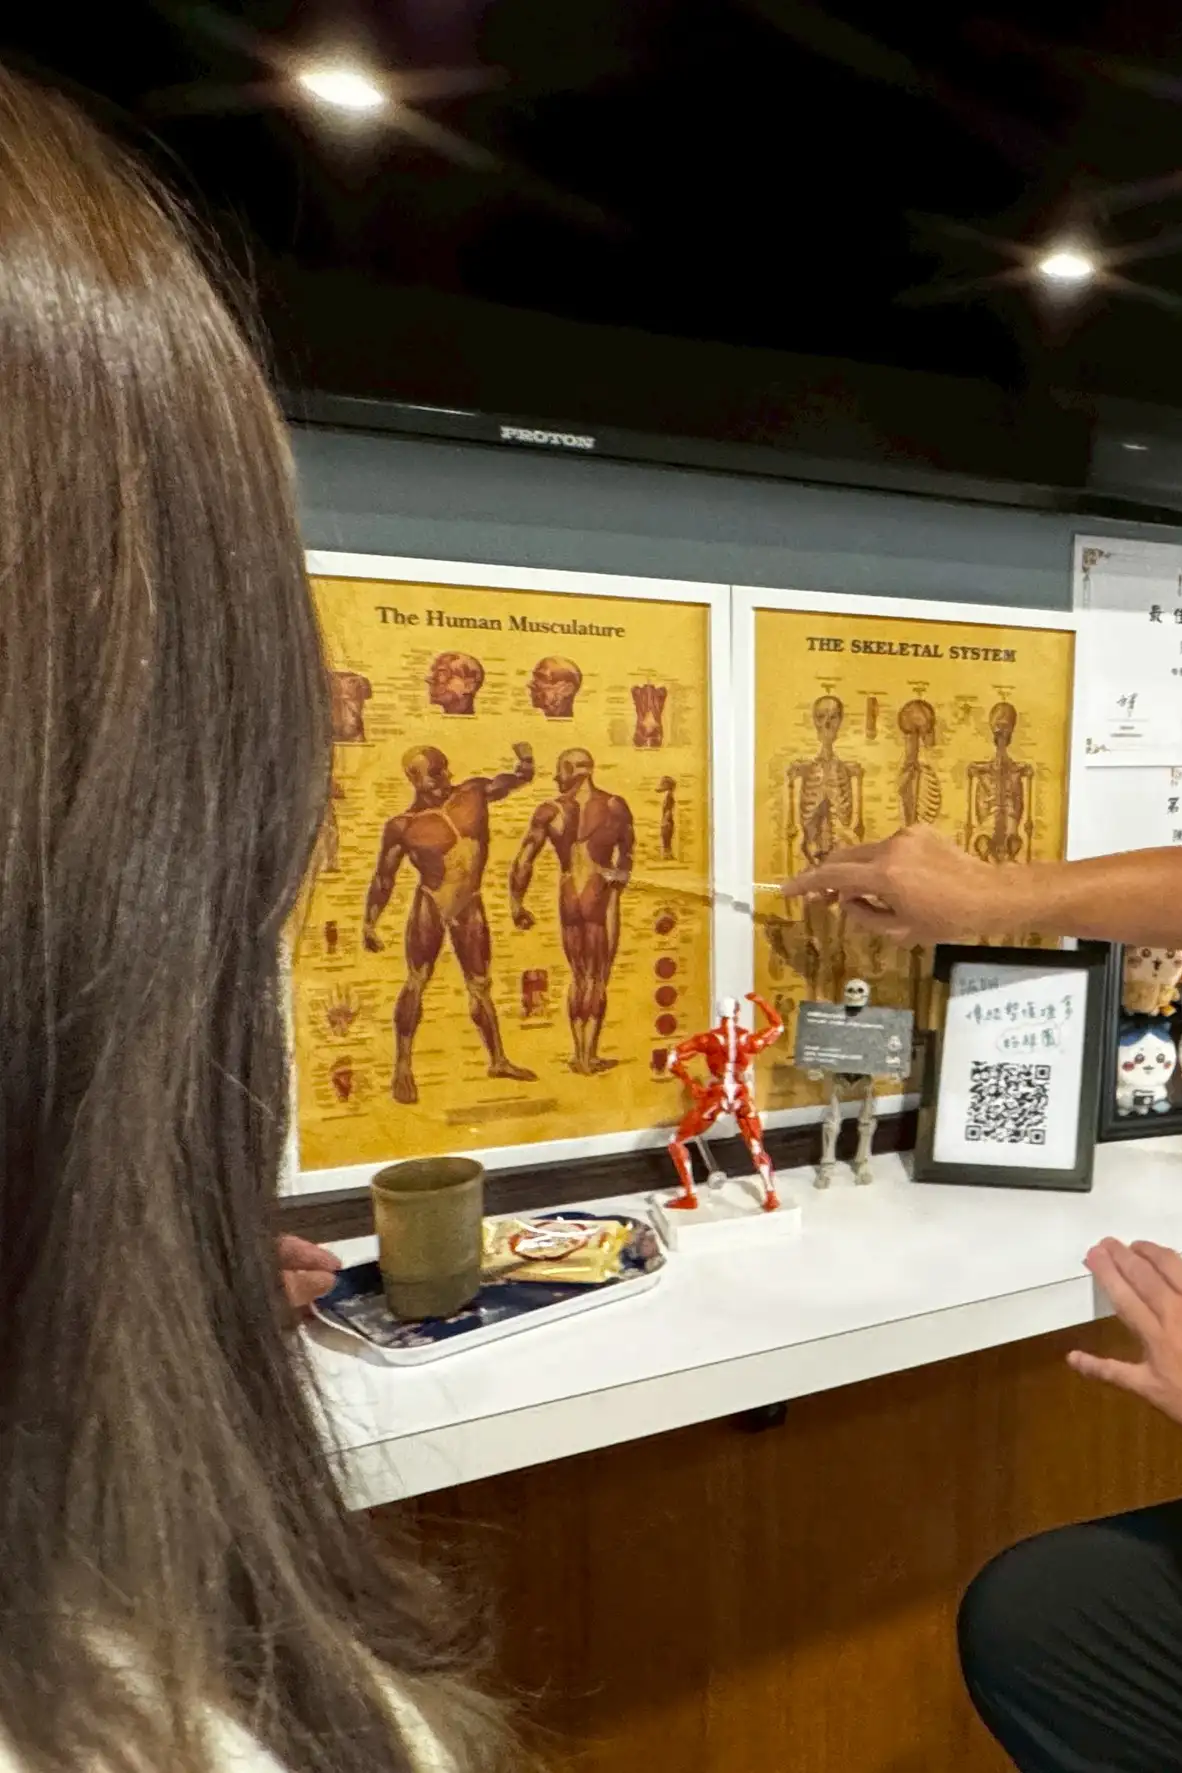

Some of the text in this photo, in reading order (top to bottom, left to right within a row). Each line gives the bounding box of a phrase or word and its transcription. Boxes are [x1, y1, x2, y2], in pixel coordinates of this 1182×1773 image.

[500, 426, 596, 449] PROTON
[375, 606, 626, 638] The Human Musculature
[806, 637, 1018, 663] THE SKELETAL SYSTEM
